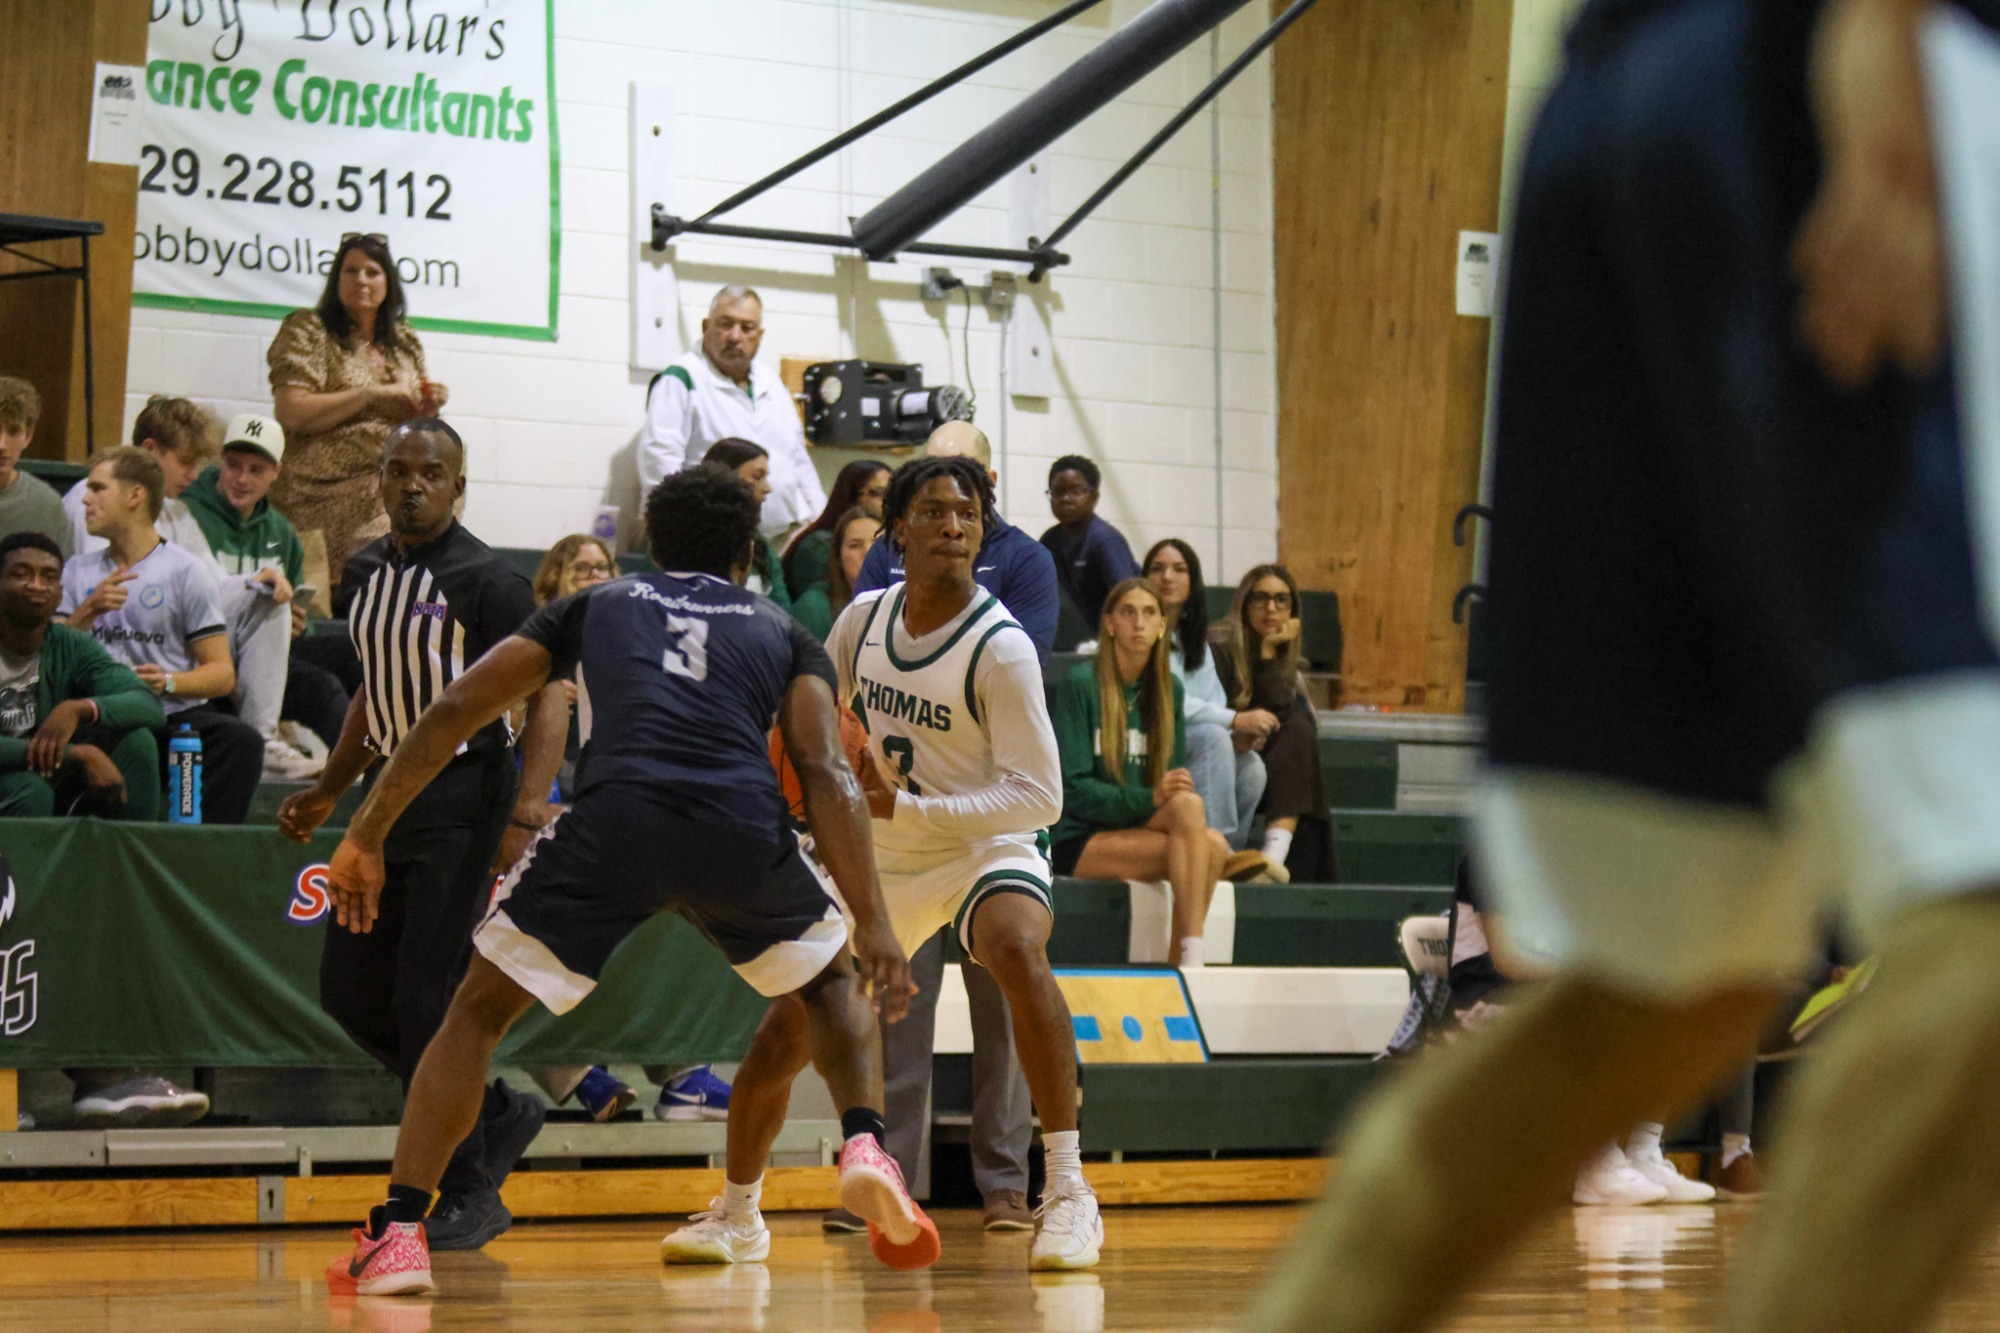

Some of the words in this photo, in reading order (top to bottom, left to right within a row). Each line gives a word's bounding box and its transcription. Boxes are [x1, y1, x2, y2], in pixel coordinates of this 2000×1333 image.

[146, 59, 261, 115] ance
[273, 58, 534, 142] Consultants
[140, 144, 452, 221] 29.228.5112
[414, 601, 447, 622] NAIA
[628, 582, 755, 615] Roadrunners
[662, 612, 709, 682] 3
[860, 675, 951, 732] THOMAS
[182, 752, 192, 814] POWERADE
[1417, 937, 1450, 957] THO
[0, 938, 38, 1036] S
